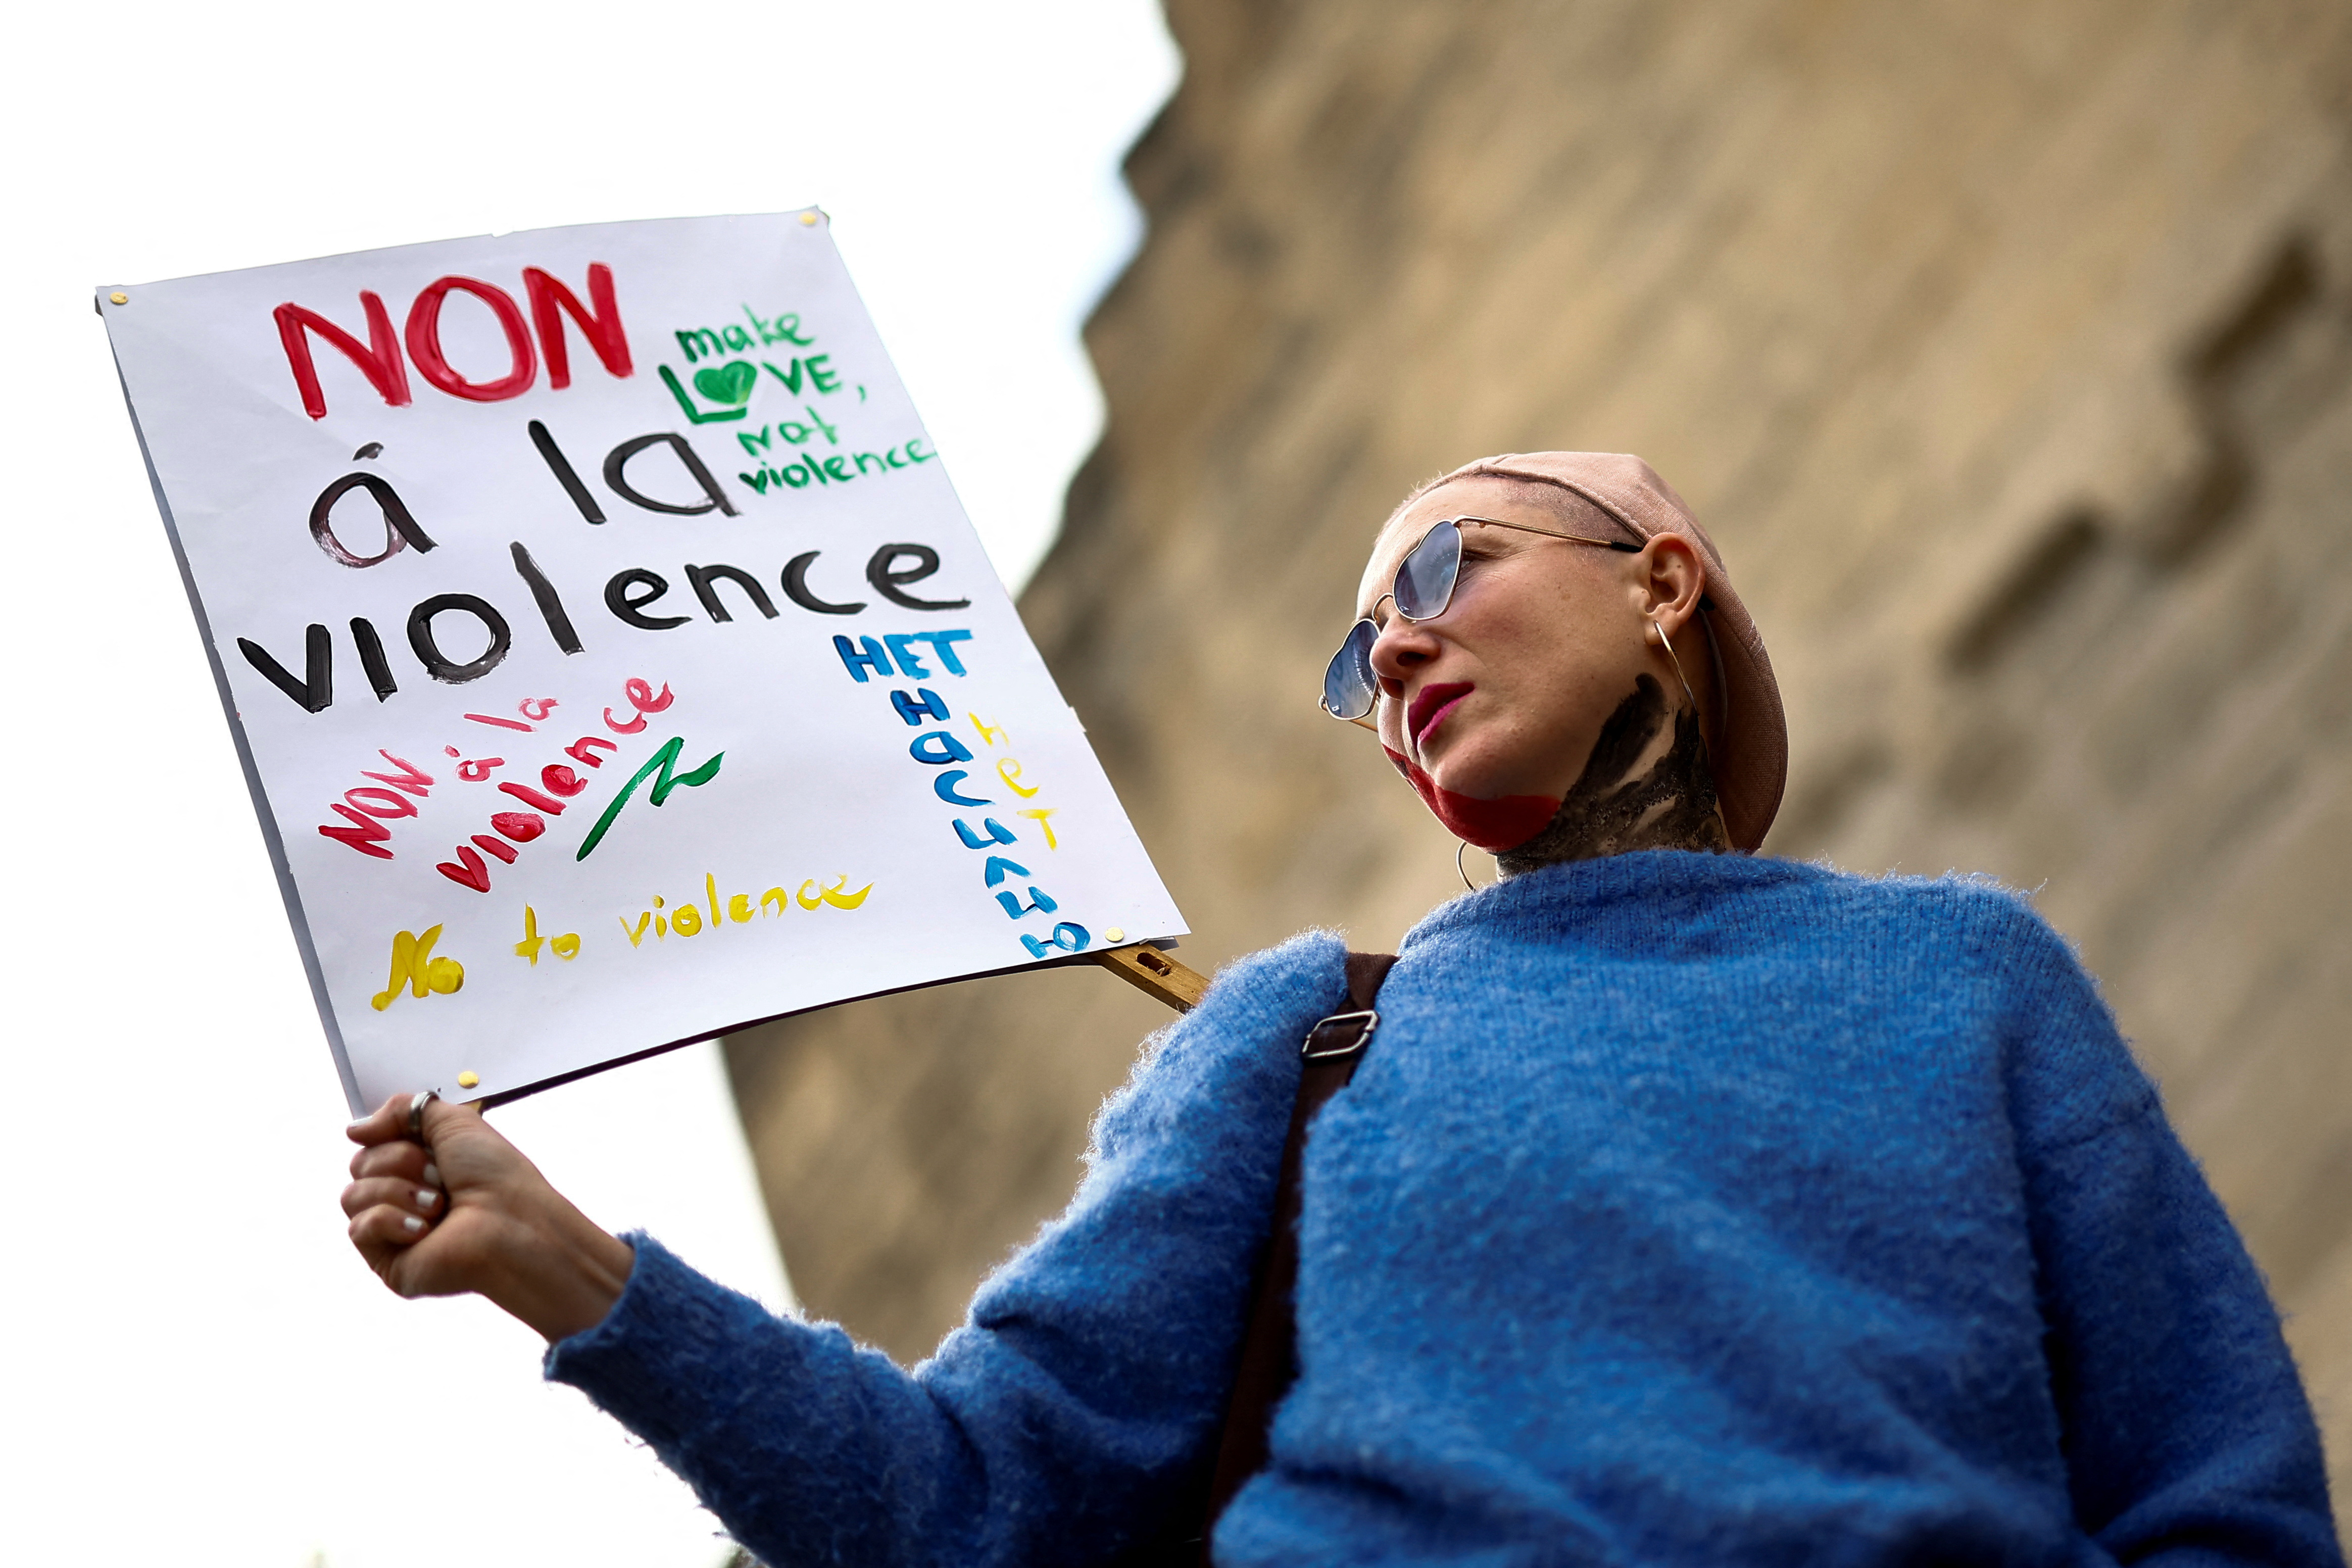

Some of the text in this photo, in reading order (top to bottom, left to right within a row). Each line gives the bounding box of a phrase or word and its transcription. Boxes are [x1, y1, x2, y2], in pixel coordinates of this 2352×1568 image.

[273, 262, 634, 421] NON
[674, 303, 817, 363] make
[528, 420, 743, 526] la
[738, 438, 938, 496] violence
[832, 629, 974, 683] НЕТ
[317, 748, 435, 860] NON
[463, 697, 560, 733] la
[370, 871, 875, 1012] No to violence
